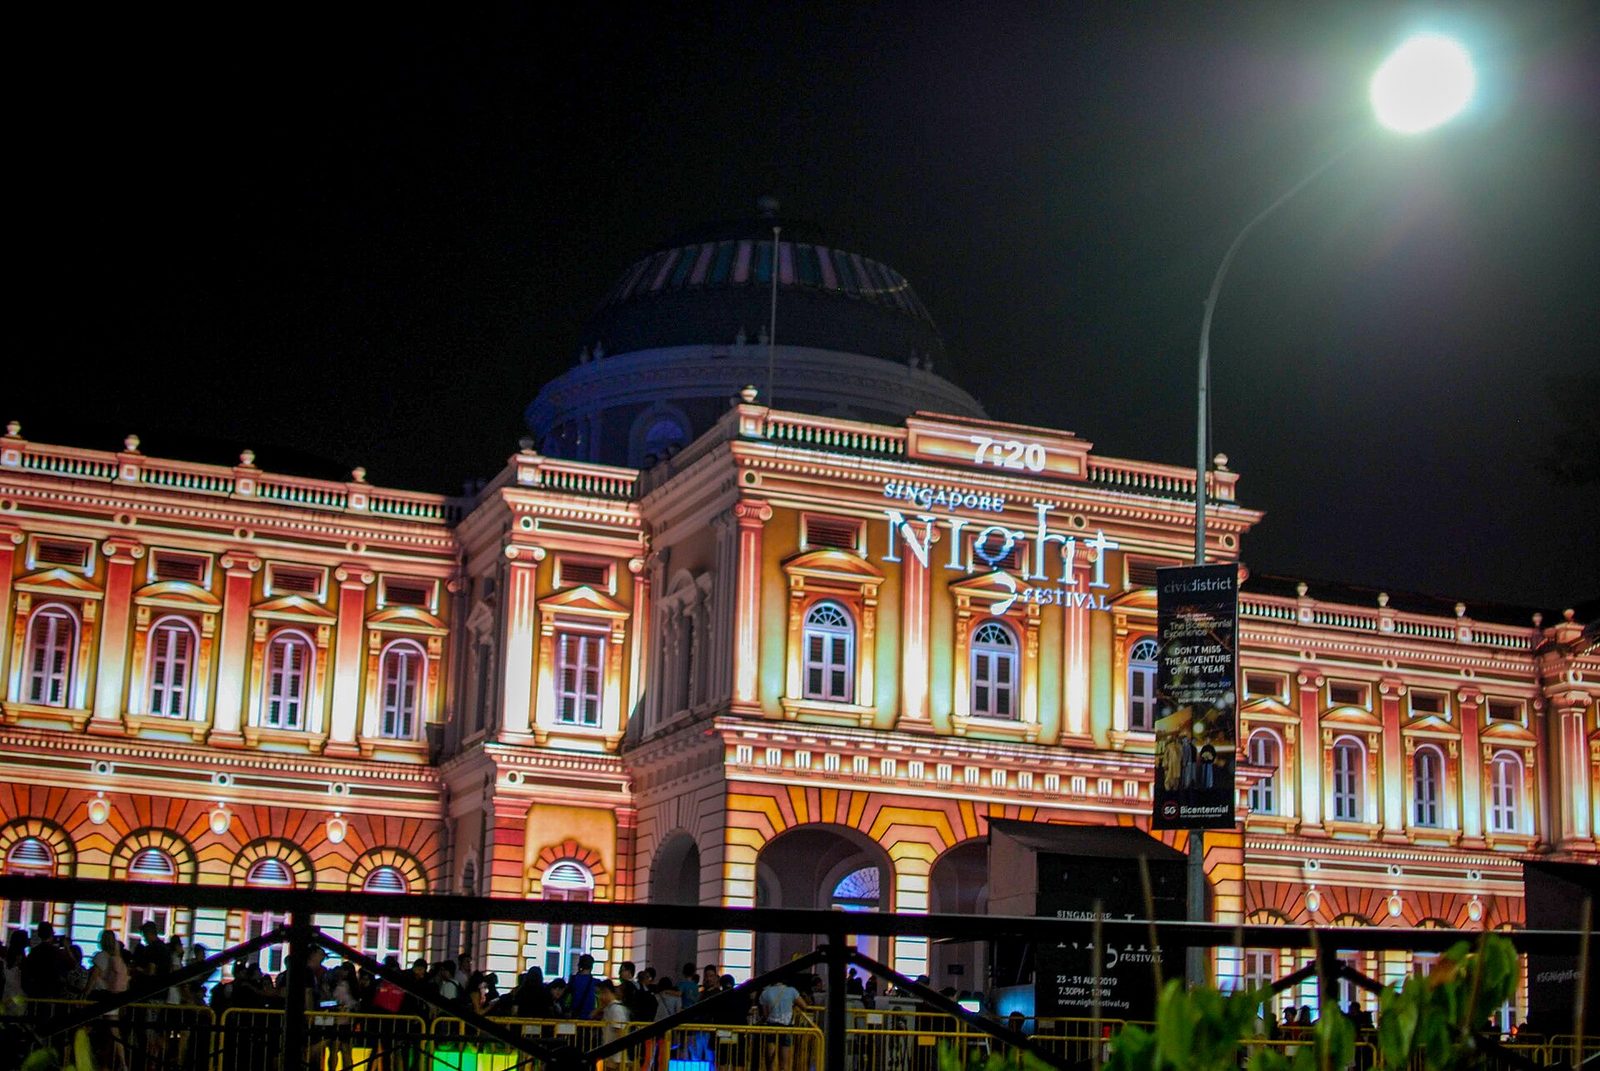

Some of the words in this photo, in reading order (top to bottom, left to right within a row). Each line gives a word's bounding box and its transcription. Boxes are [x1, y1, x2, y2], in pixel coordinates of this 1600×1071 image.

[971, 435, 1046, 472] 7:20
[884, 483, 1005, 512] SINGAPORE
[1023, 587, 1111, 611] FESTIVAL
[1174, 645, 1200, 655] DON'T
[1201, 645, 1222, 654] MISS
[1165, 657, 1181, 666] THE
[1182, 654, 1232, 665] ADVENTURE
[1170, 667, 1182, 675] OF
[1184, 665, 1200, 674] THE
[1201, 664, 1226, 674] YEAR
[1180, 805, 1229, 814] Bicentennial
[1056, 975, 1067, 983] 23
[1073, 976, 1082, 984] 31
[1100, 977, 1118, 986] 2019
